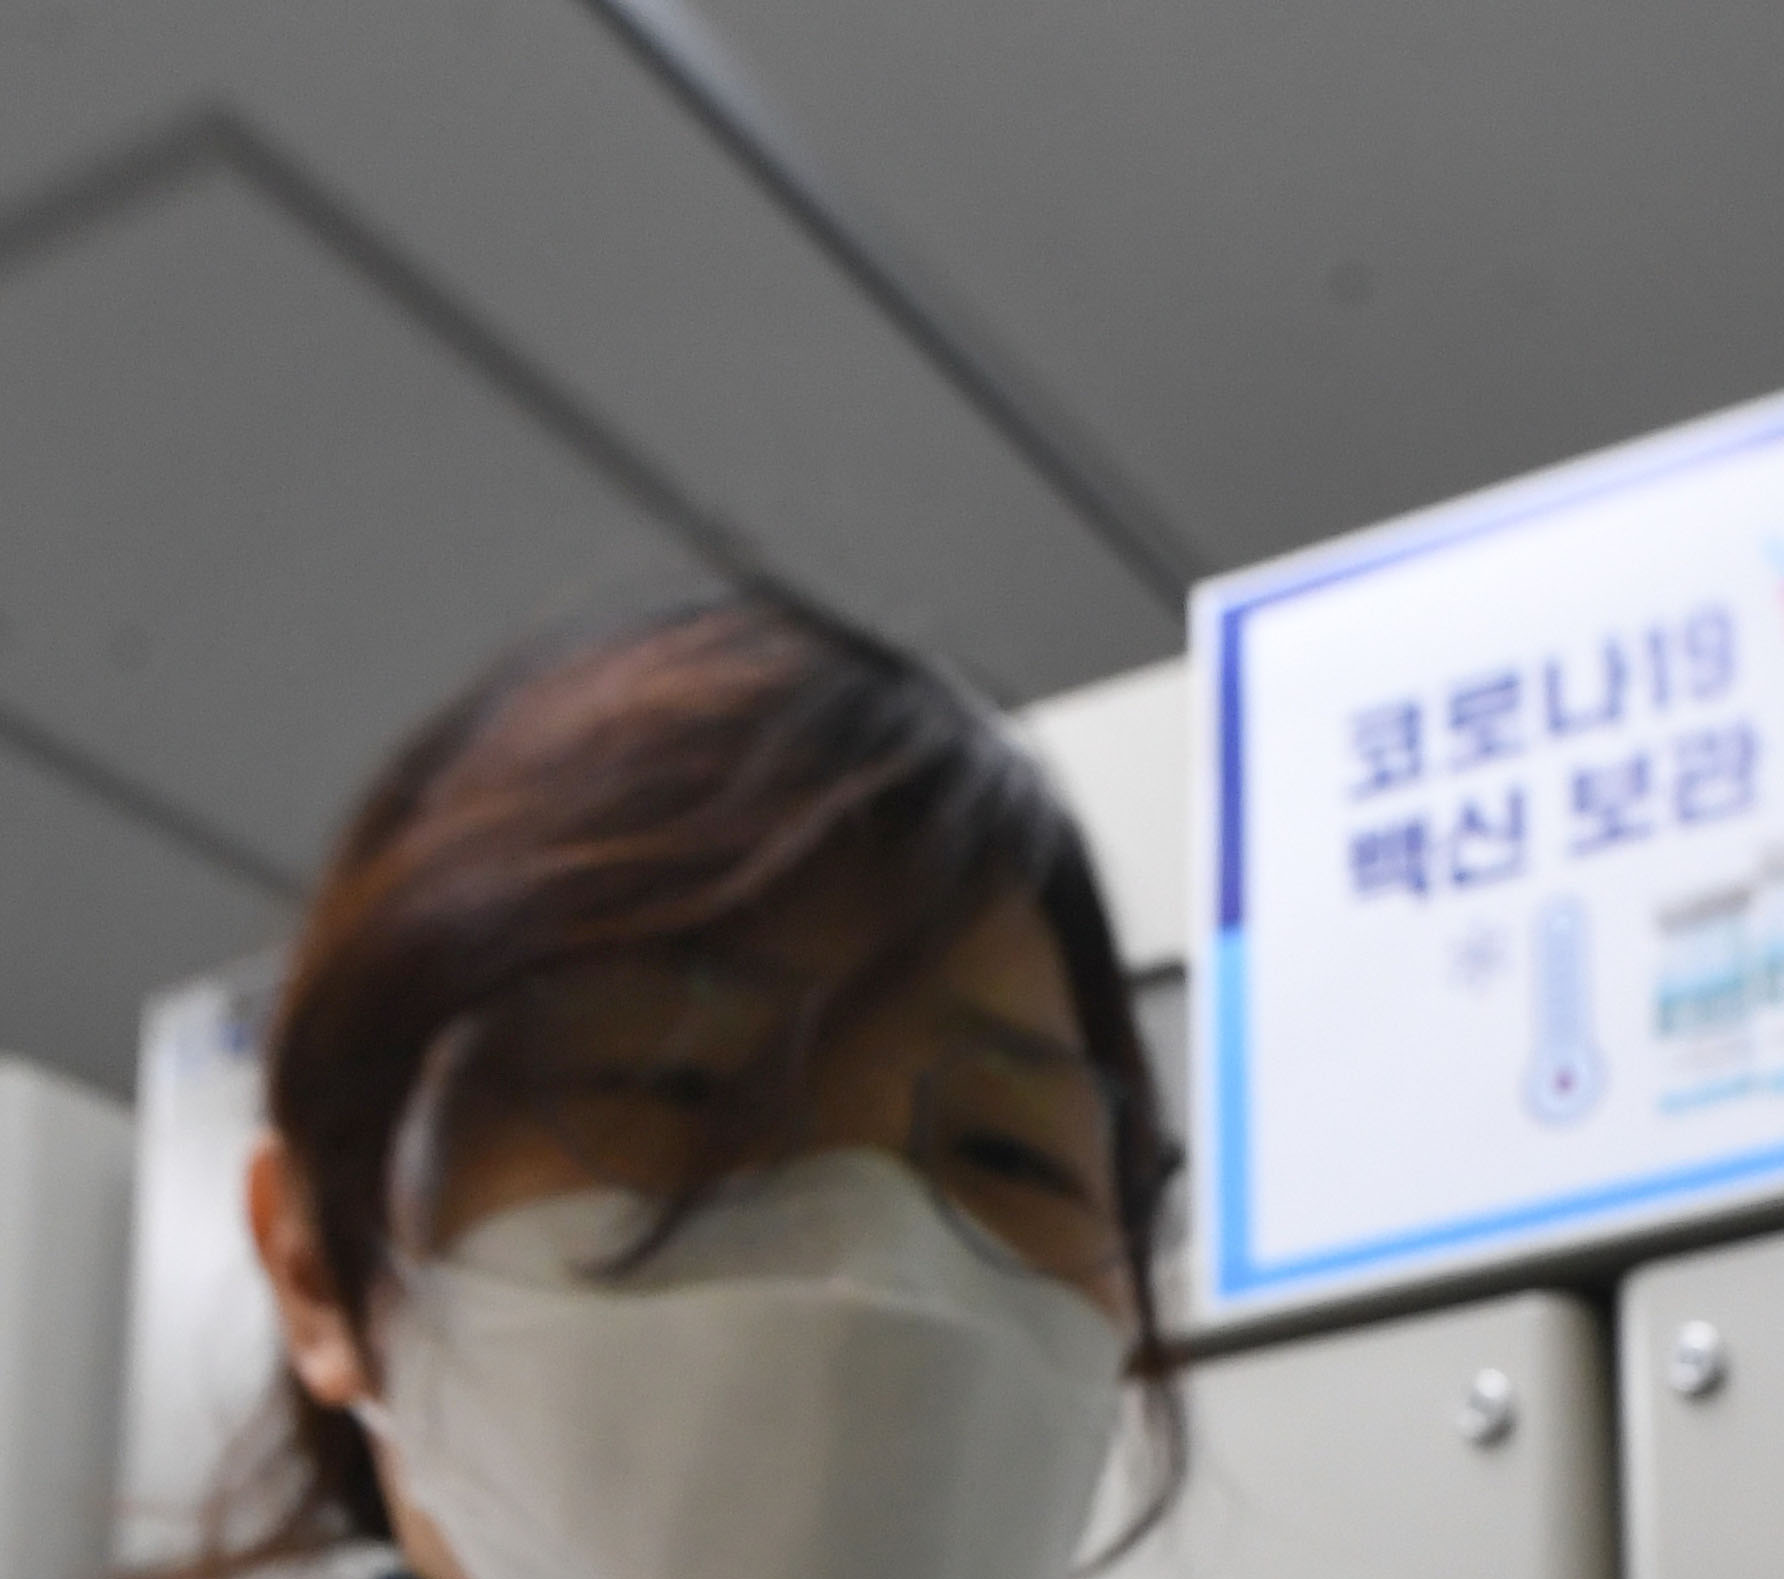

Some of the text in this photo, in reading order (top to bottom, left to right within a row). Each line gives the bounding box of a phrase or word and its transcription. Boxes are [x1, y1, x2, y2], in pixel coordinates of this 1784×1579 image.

[1345, 600, 1742, 802] 코로나19
[1344, 782, 1531, 902] 백신
[1562, 717, 1763, 857] 보관
